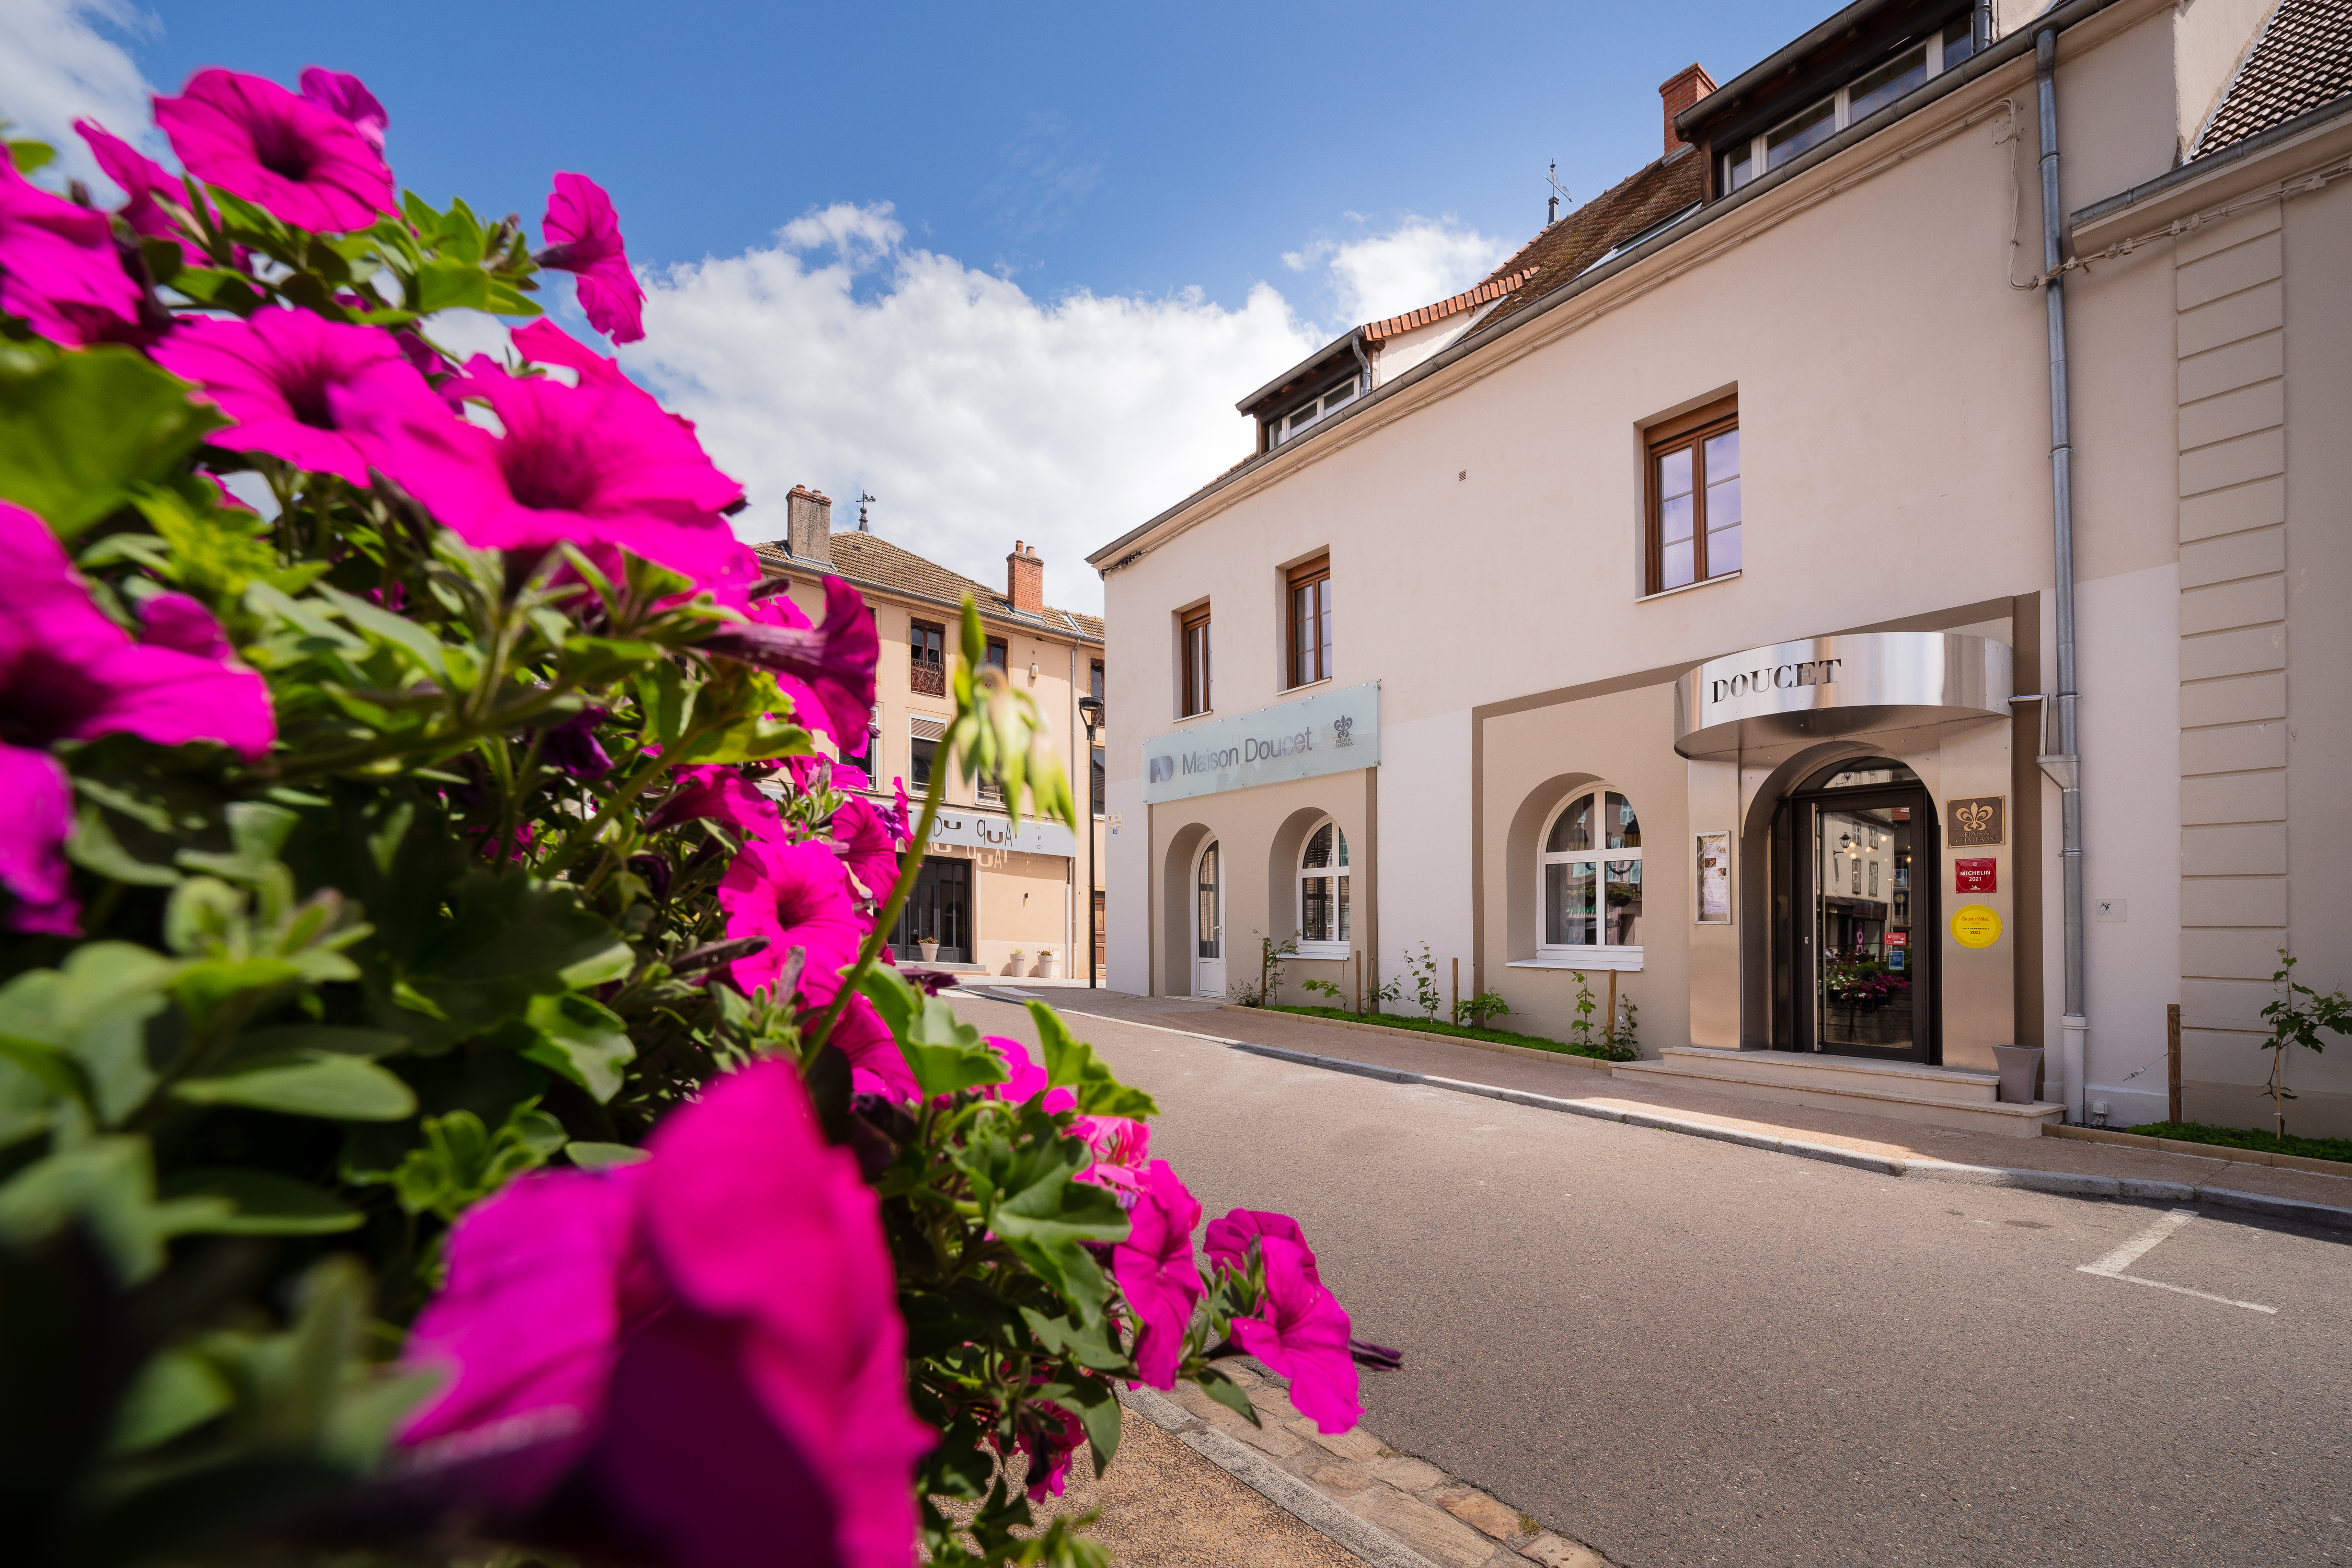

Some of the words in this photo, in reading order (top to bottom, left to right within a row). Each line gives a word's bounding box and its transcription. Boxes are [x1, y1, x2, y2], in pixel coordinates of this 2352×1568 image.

[1711, 659, 1842, 704] DOUCET
[1183, 747, 1239, 776] Maison
[1245, 727, 1312, 763] Doucet
